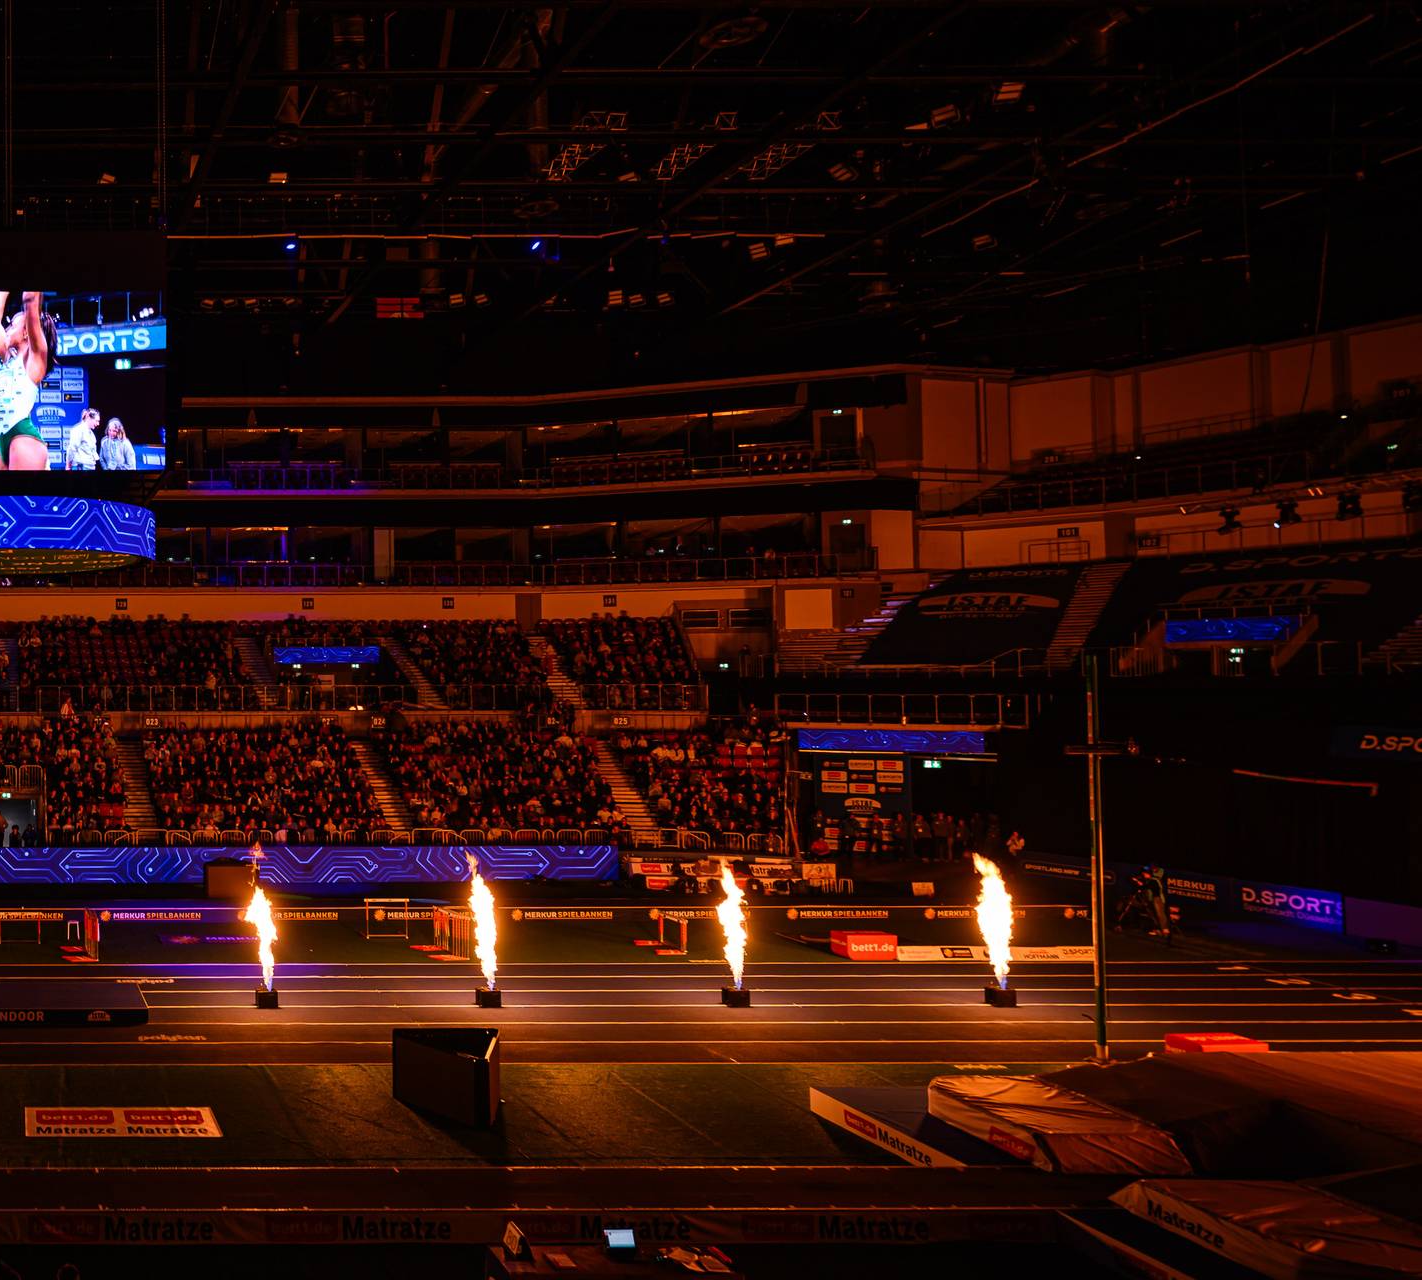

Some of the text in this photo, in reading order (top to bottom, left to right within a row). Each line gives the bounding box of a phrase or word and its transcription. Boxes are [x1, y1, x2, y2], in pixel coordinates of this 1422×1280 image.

[946, 594, 1030, 607] ISTAF
[1167, 878, 1216, 891] MERKUR
[851, 943, 895, 952] bett1.de
[41, 1111, 197, 1121] bett1.de bett1.de
[36, 1126, 208, 1135] Matratze Matratze
[877, 1127, 932, 1167] Matratze
[104, 1216, 214, 1241] Matratze
[342, 1216, 451, 1240] Matratze
[818, 1216, 930, 1240] Matratze
[1146, 1199, 1225, 1249] Matratze
